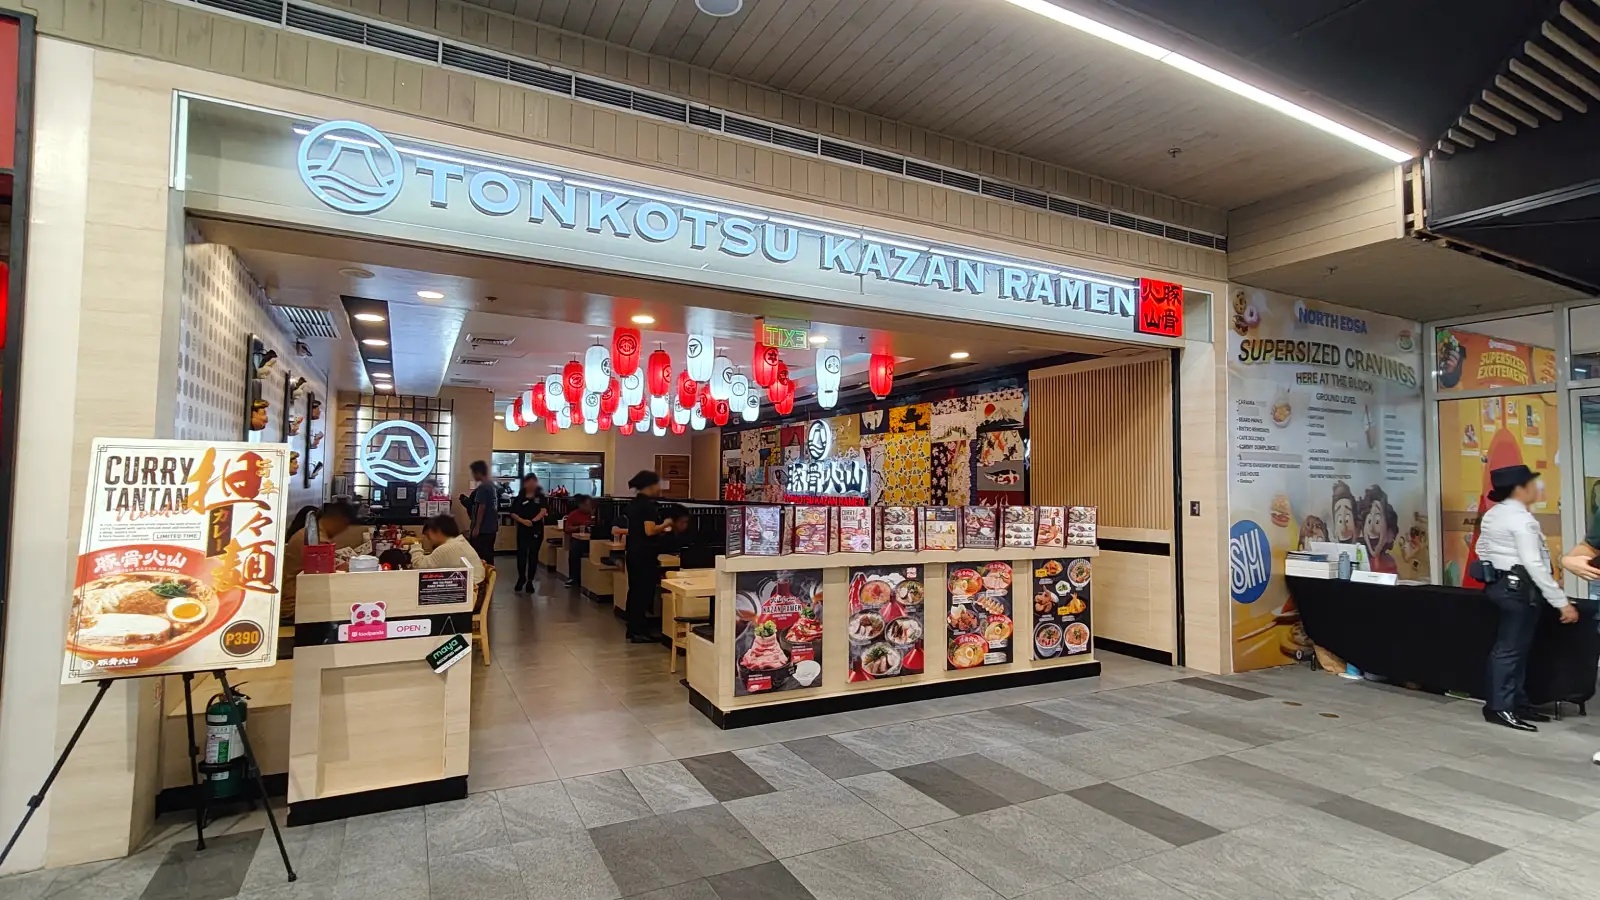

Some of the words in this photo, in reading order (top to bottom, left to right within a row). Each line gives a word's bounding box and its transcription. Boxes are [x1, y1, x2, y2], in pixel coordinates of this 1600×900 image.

[416, 158, 799, 262] TONKOTSU
[819, 235, 985, 295] KAZAN
[997, 268, 1136, 317] RAMEN
[1298, 308, 1338, 330] NORTH
[1340, 315, 1367, 334] EDSA
[1238, 339, 1340, 366] SUPERSIZED
[1345, 348, 1416, 387] CRAVINGS
[1477, 364, 1529, 386] EXCITEMENT
[1480, 351, 1527, 375] SUPERSIZED
[1296, 372, 1318, 384] HERE
[1320, 373, 1330, 384] AT
[1331, 374, 1347, 387] THE
[1316, 393, 1339, 402] GROUND
[1340, 396, 1357, 404] LEVEL
[105, 456, 194, 485] CURRY
[786, 460, 867, 493] 豚骨火山
[105, 487, 189, 512] TANTAN
[94, 549, 187, 573] 豚骨火山
[1230, 528, 1267, 594] SM
[396, 624, 421, 633] OPEN
[432, 639, 459, 660] maya
